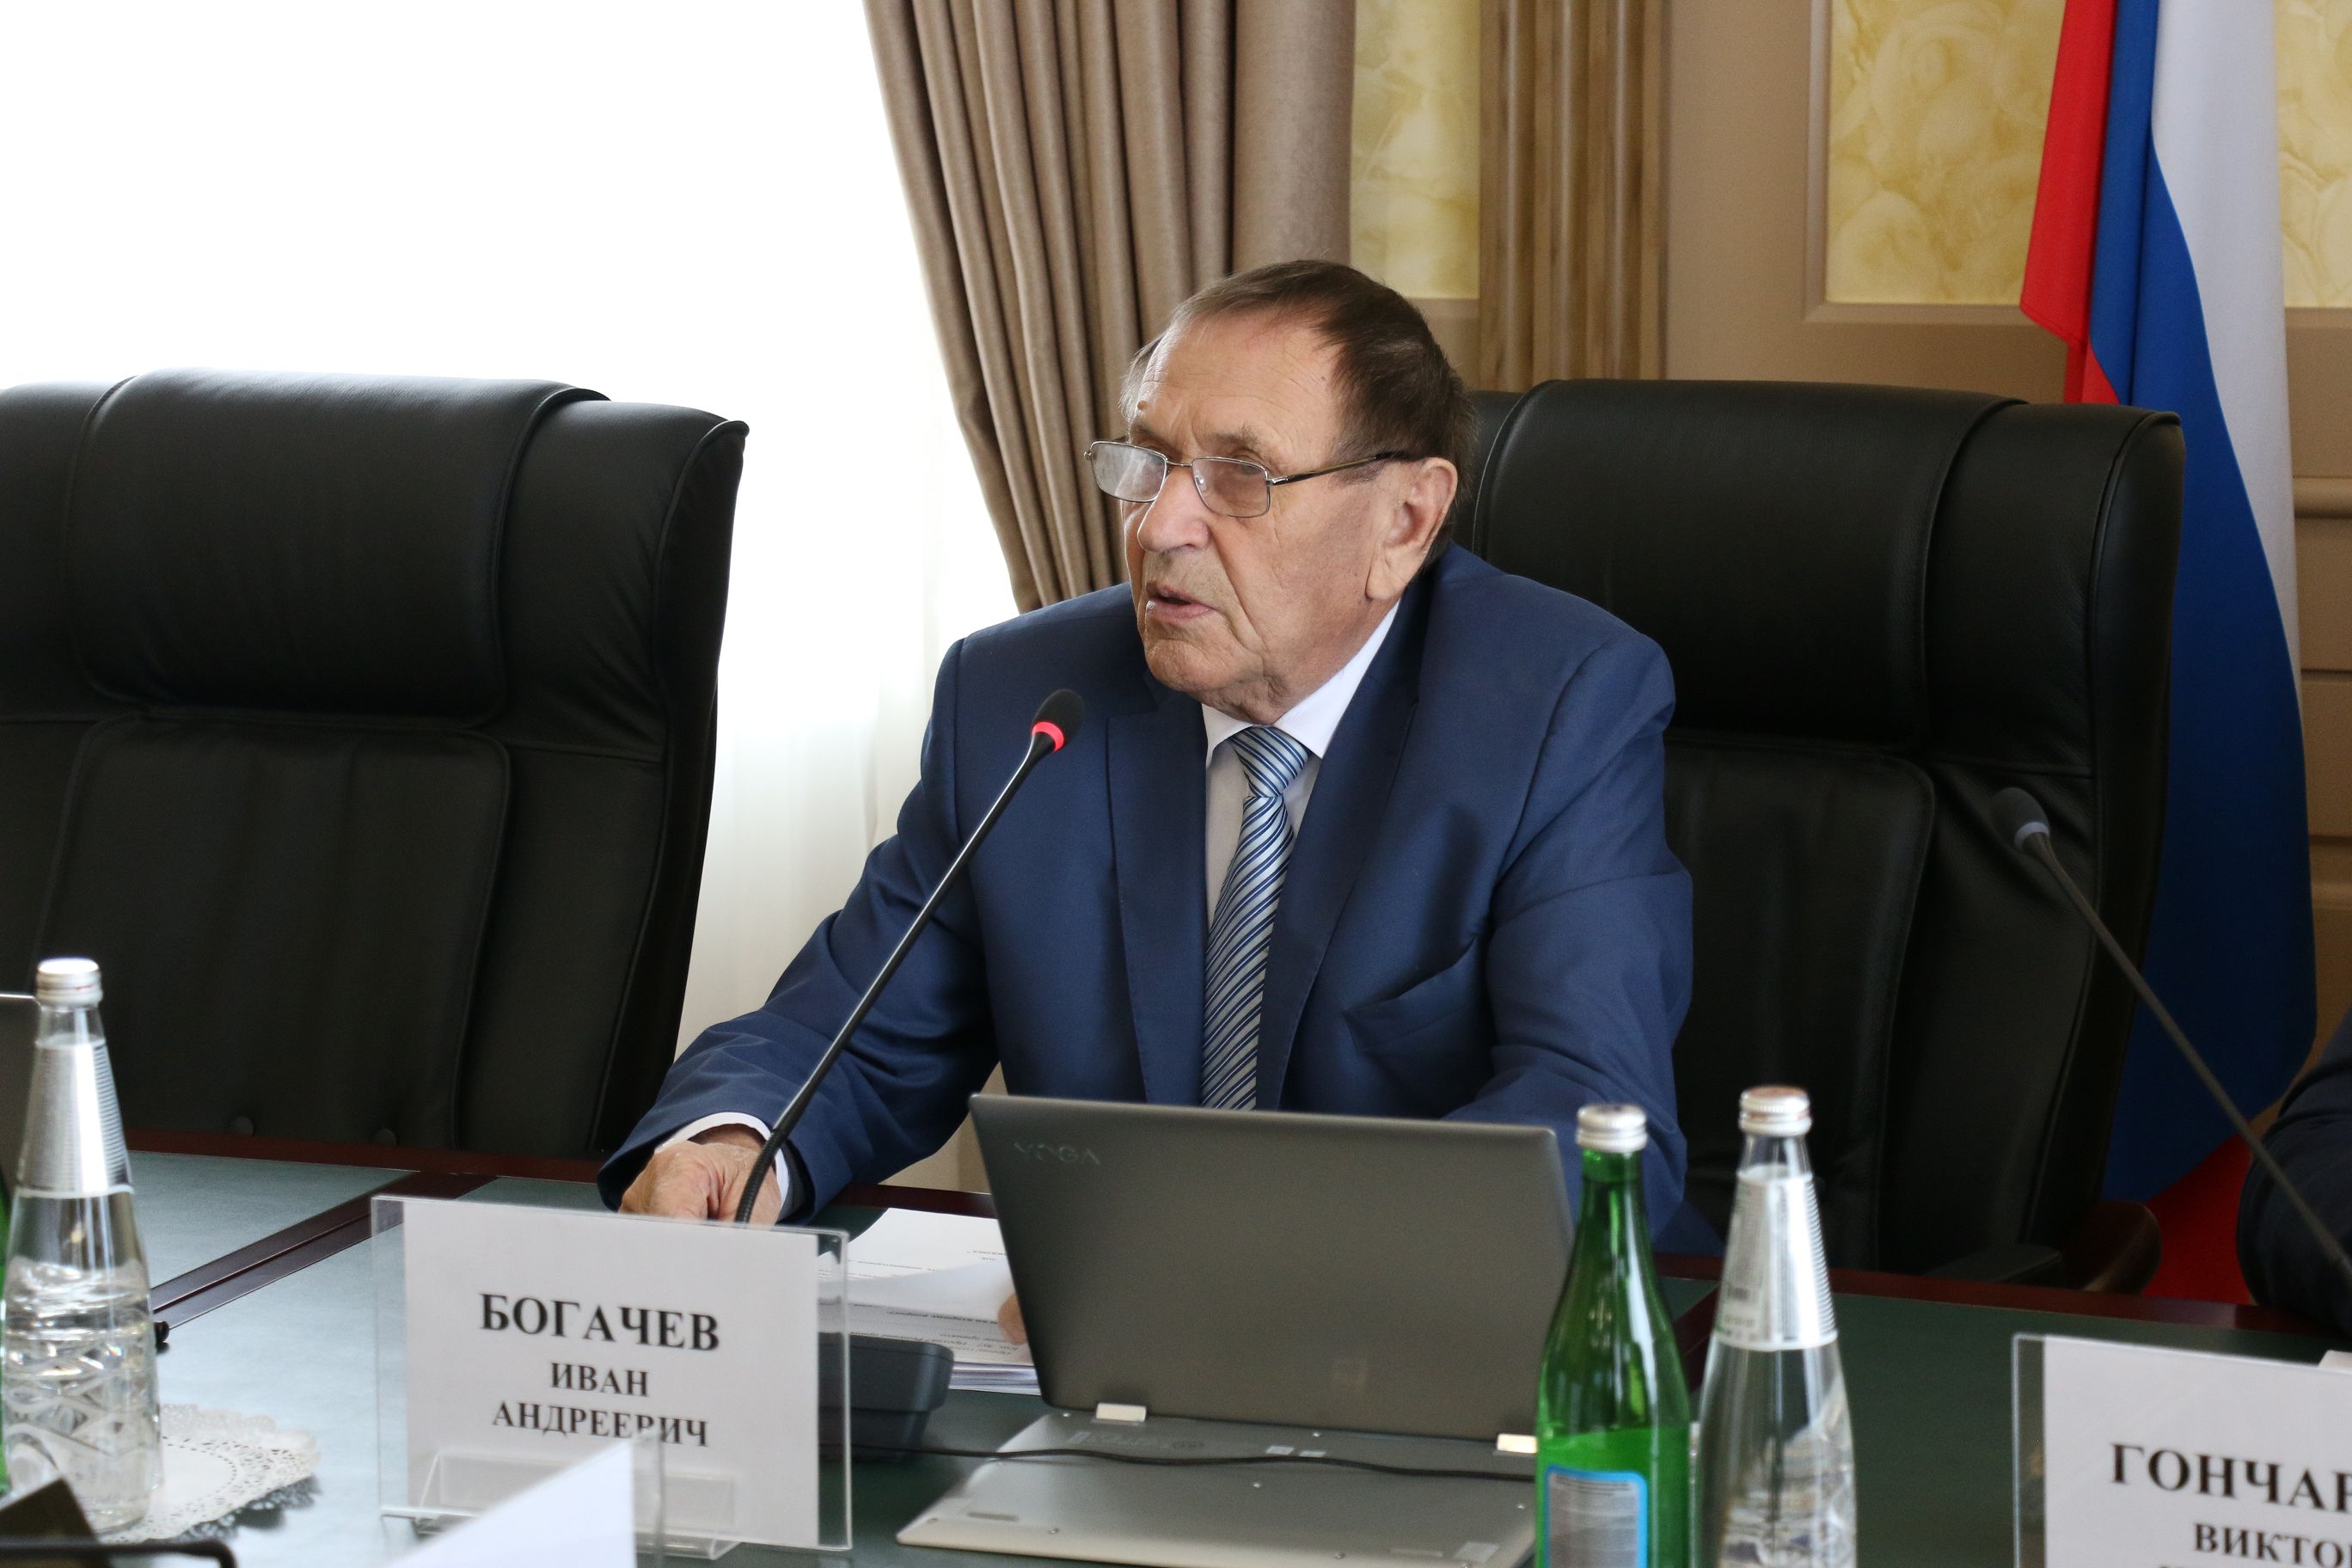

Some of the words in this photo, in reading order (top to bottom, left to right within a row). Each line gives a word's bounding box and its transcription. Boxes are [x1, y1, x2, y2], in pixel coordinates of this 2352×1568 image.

[480, 1292, 720, 1351] БОГАЧЕВ
[550, 1362, 649, 1398] ИВАН
[2194, 1522, 2352, 1568] ВИКТО
